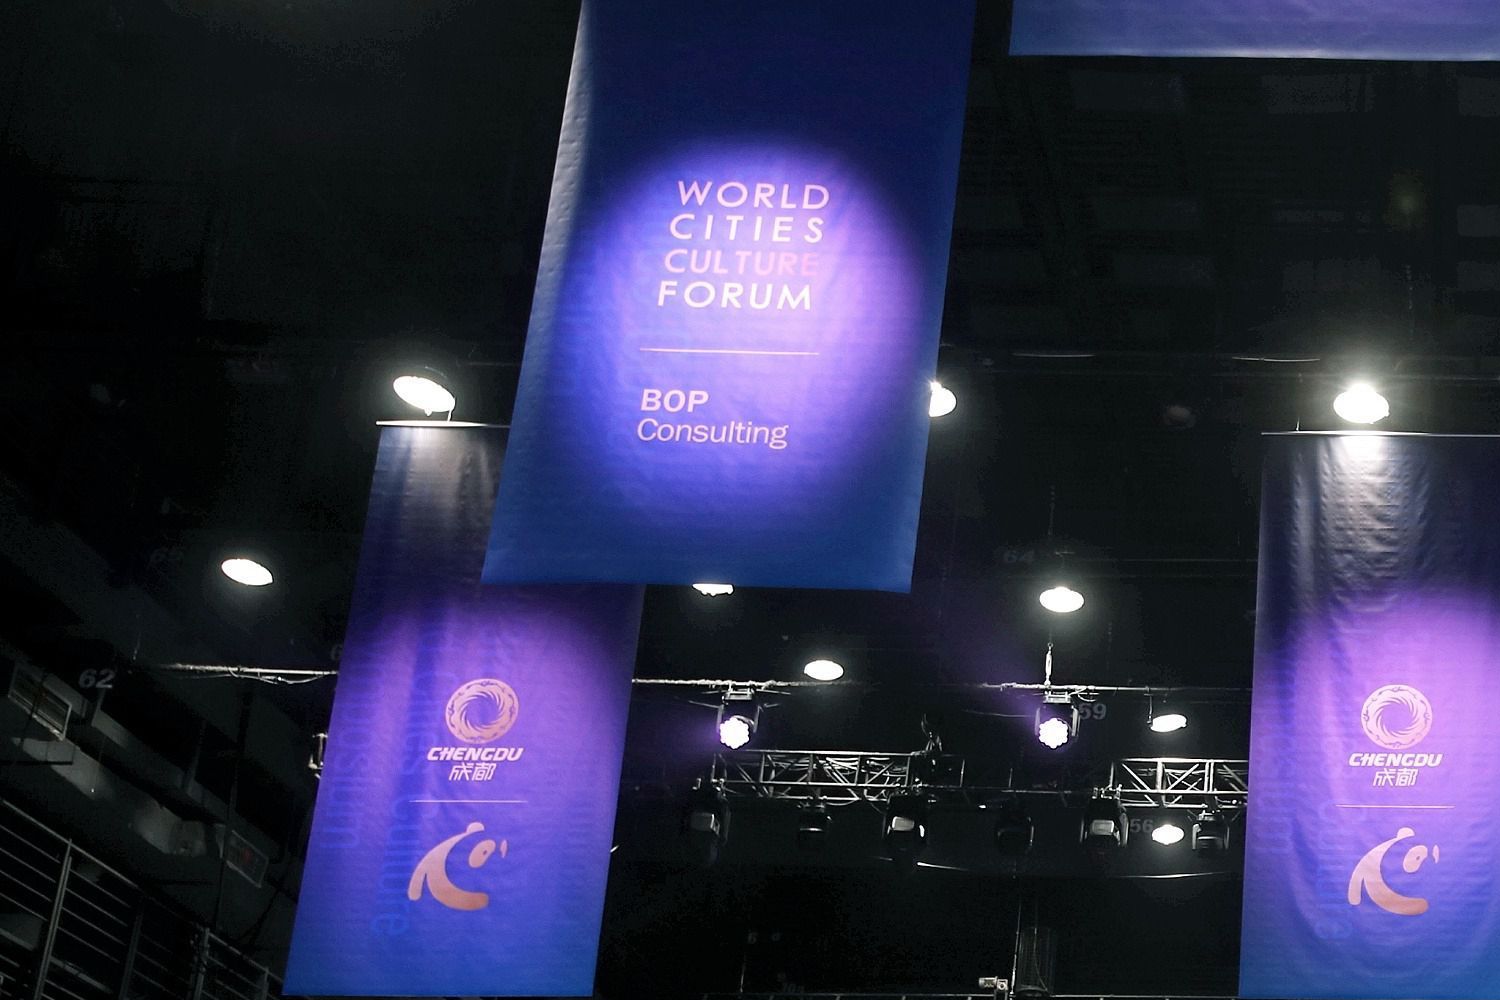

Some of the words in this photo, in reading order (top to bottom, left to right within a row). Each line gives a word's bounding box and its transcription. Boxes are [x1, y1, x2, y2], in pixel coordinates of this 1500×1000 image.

[676, 180, 831, 211] WORLD
[669, 212, 826, 245] CITIES
[663, 247, 819, 278] CULTURE
[656, 280, 814, 312] FORUM
[640, 388, 710, 414] BOP
[636, 418, 789, 450] Consulting
[78, 668, 117, 689] 62
[1078, 703, 1108, 720] 59
[427, 746, 524, 762] CHENGDU
[1348, 752, 1443, 768] CHENGDU
[448, 762, 497, 782] 成都
[1372, 768, 1419, 787] 成都
